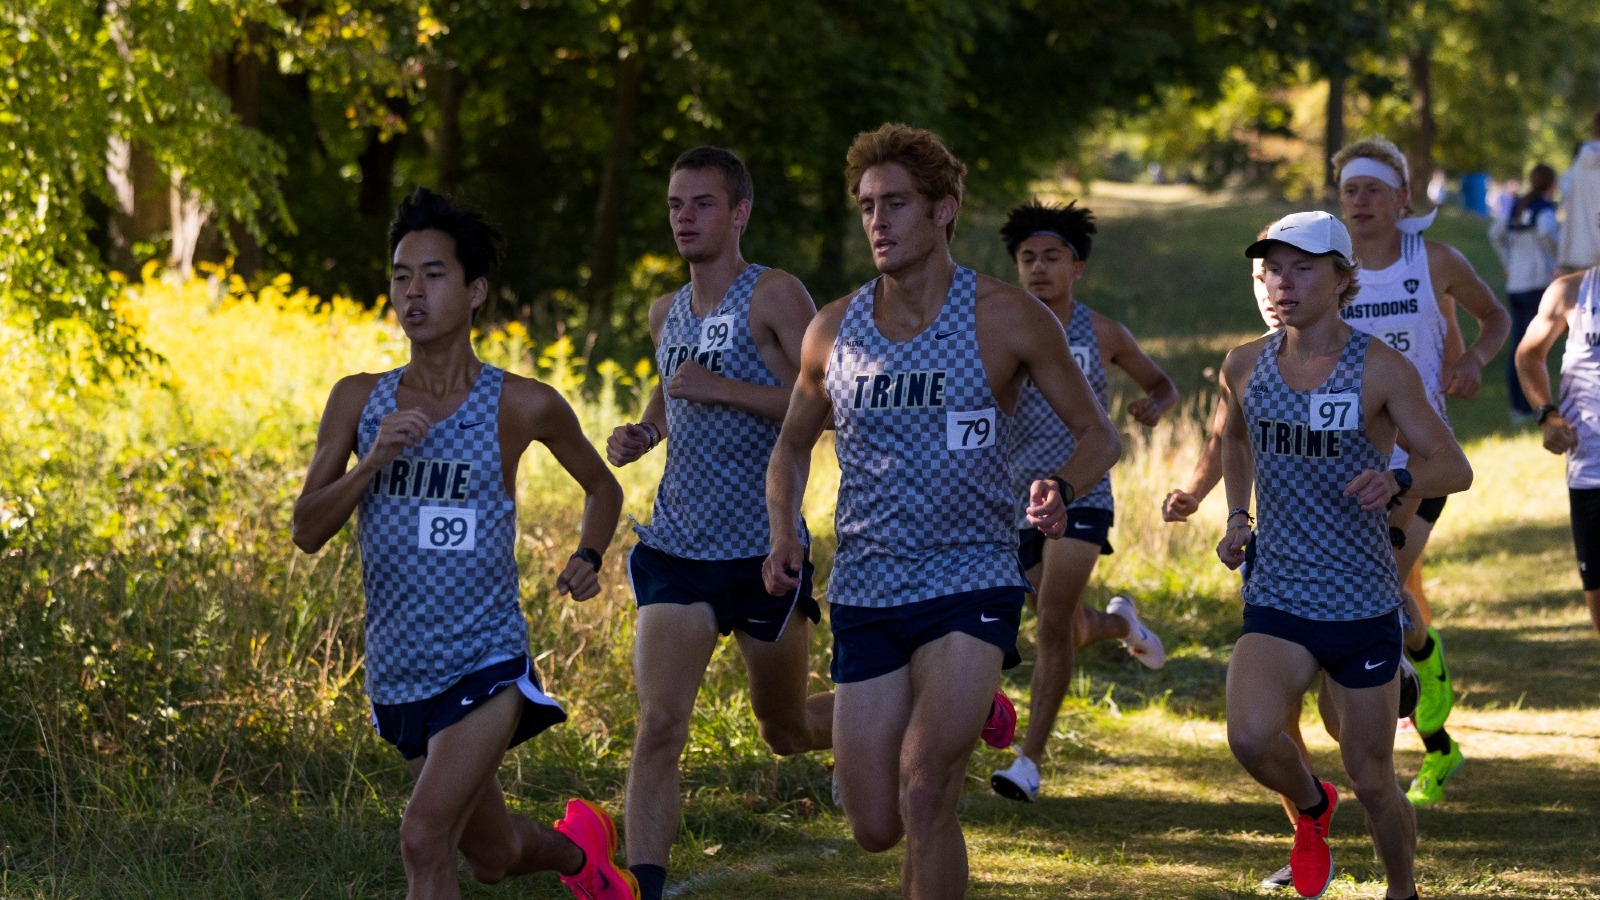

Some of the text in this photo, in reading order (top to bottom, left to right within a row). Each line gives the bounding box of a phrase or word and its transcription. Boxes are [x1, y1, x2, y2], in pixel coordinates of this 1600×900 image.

[706, 322, 729, 349] 99
[1384, 331, 1410, 352] 35
[853, 370, 947, 410] TRINE
[1318, 401, 1352, 428] 97
[956, 417, 991, 447] 79
[1258, 419, 1342, 459] TRINE
[430, 516, 468, 547] 89
